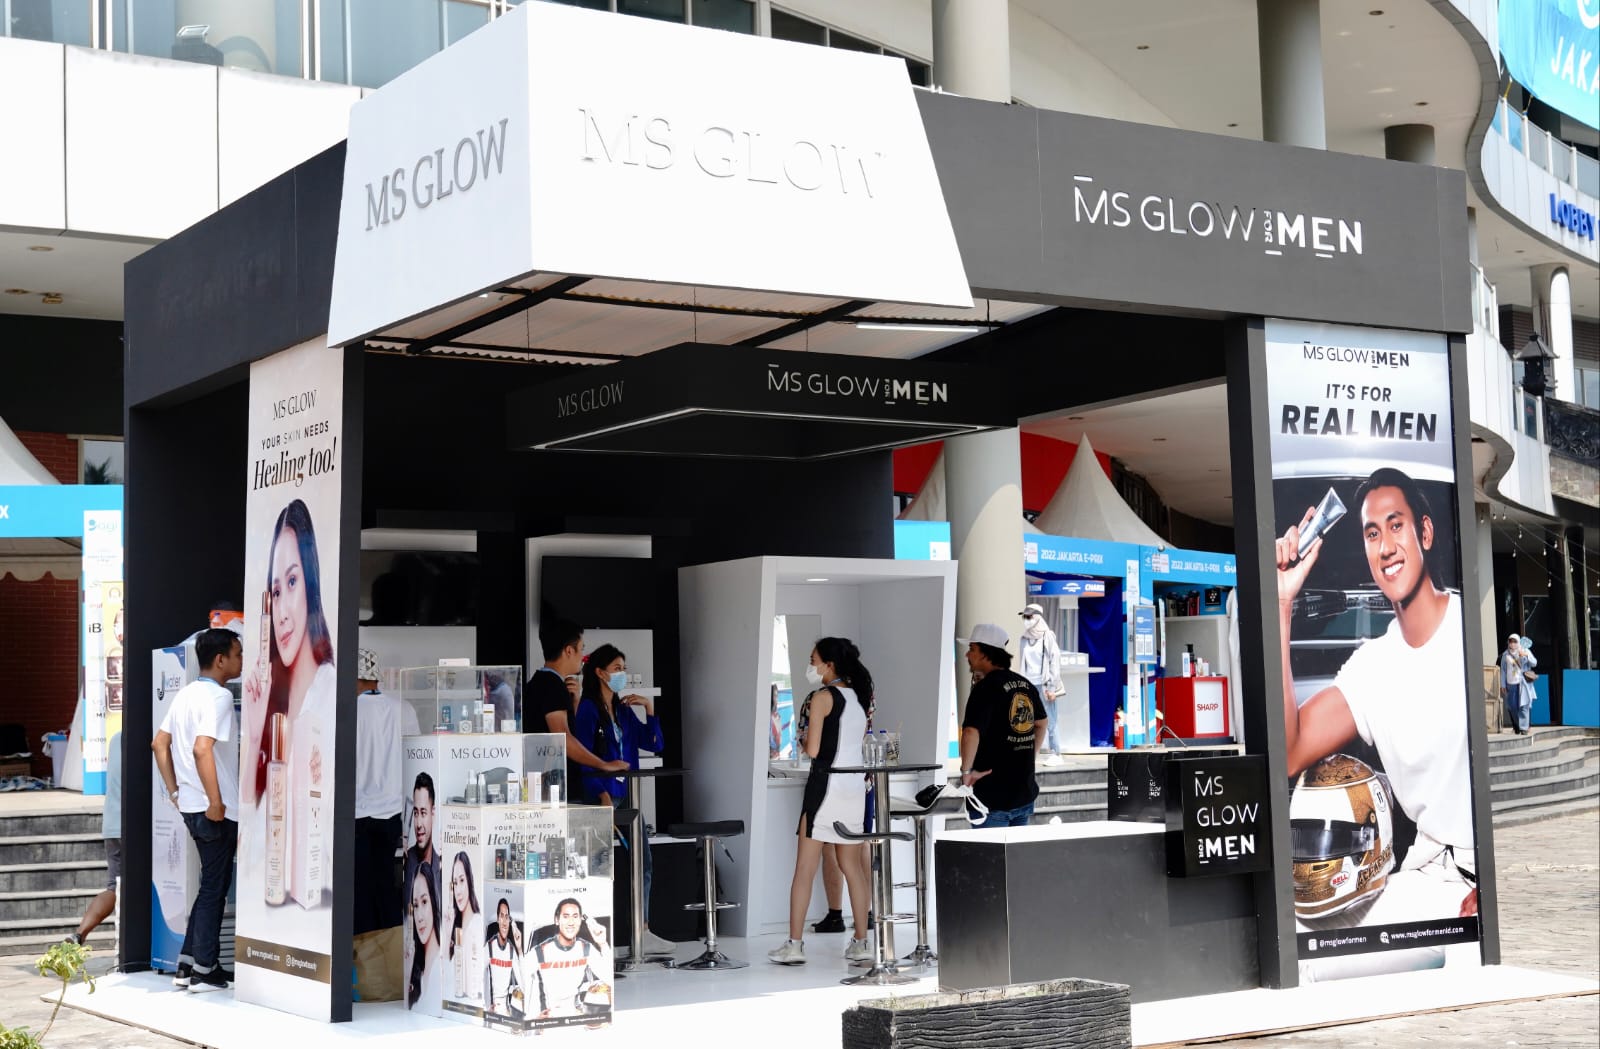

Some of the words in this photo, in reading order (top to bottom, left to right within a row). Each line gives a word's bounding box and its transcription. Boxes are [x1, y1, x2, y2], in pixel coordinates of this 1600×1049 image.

[578, 106, 674, 170] MS
[365, 168, 406, 231] MS
[412, 118, 508, 209] GLOW
[1074, 186, 1131, 227] MS
[1140, 196, 1256, 241] GLOW
[1263, 210, 1273, 243] FOR
[1277, 211, 1362, 254] MEN
[1550, 193, 1595, 241] LOBBY
[1303, 345, 1324, 360] MS
[1326, 348, 1369, 364] GLOW
[1376, 351, 1410, 367] MEN
[768, 369, 802, 393] MS
[808, 374, 880, 397] GLOW
[892, 379, 948, 403] MEN
[1326, 383, 1356, 400] IT'S
[1361, 385, 1392, 402] FOR
[273, 399, 286, 420] MS
[287, 389, 317, 416] GLOW
[558, 393, 578, 418] MS
[580, 380, 624, 412] GLOW
[1281, 404, 1360, 437] REAL
[1370, 410, 1437, 442] MEN
[262, 434, 281, 451] YOUR
[283, 429, 301, 445] SKIN
[304, 420, 329, 439] NEEDS
[253, 450, 306, 490] Healing
[308, 436, 337, 477] too!
[1041, 549, 1057, 561] 2022
[1057, 551, 1084, 563] JAKARTA
[1084, 553, 1104, 565] E-PRIX
[1171, 560, 1183, 570] 2022
[1184, 561, 1204, 572] JAKARTA
[1205, 562, 1220, 574] E-PRIX
[1197, 703, 1218, 711] SHARP
[451, 748, 470, 760] MS
[472, 747, 512, 760] GLOW
[1194, 775, 1224, 797] MS
[1196, 803, 1259, 828] GLOW
[444, 831, 467, 846] Healing
[487, 831, 537, 846] Healing
[1205, 834, 1256, 858] MEN
[1332, 874, 1348, 886] BELL
